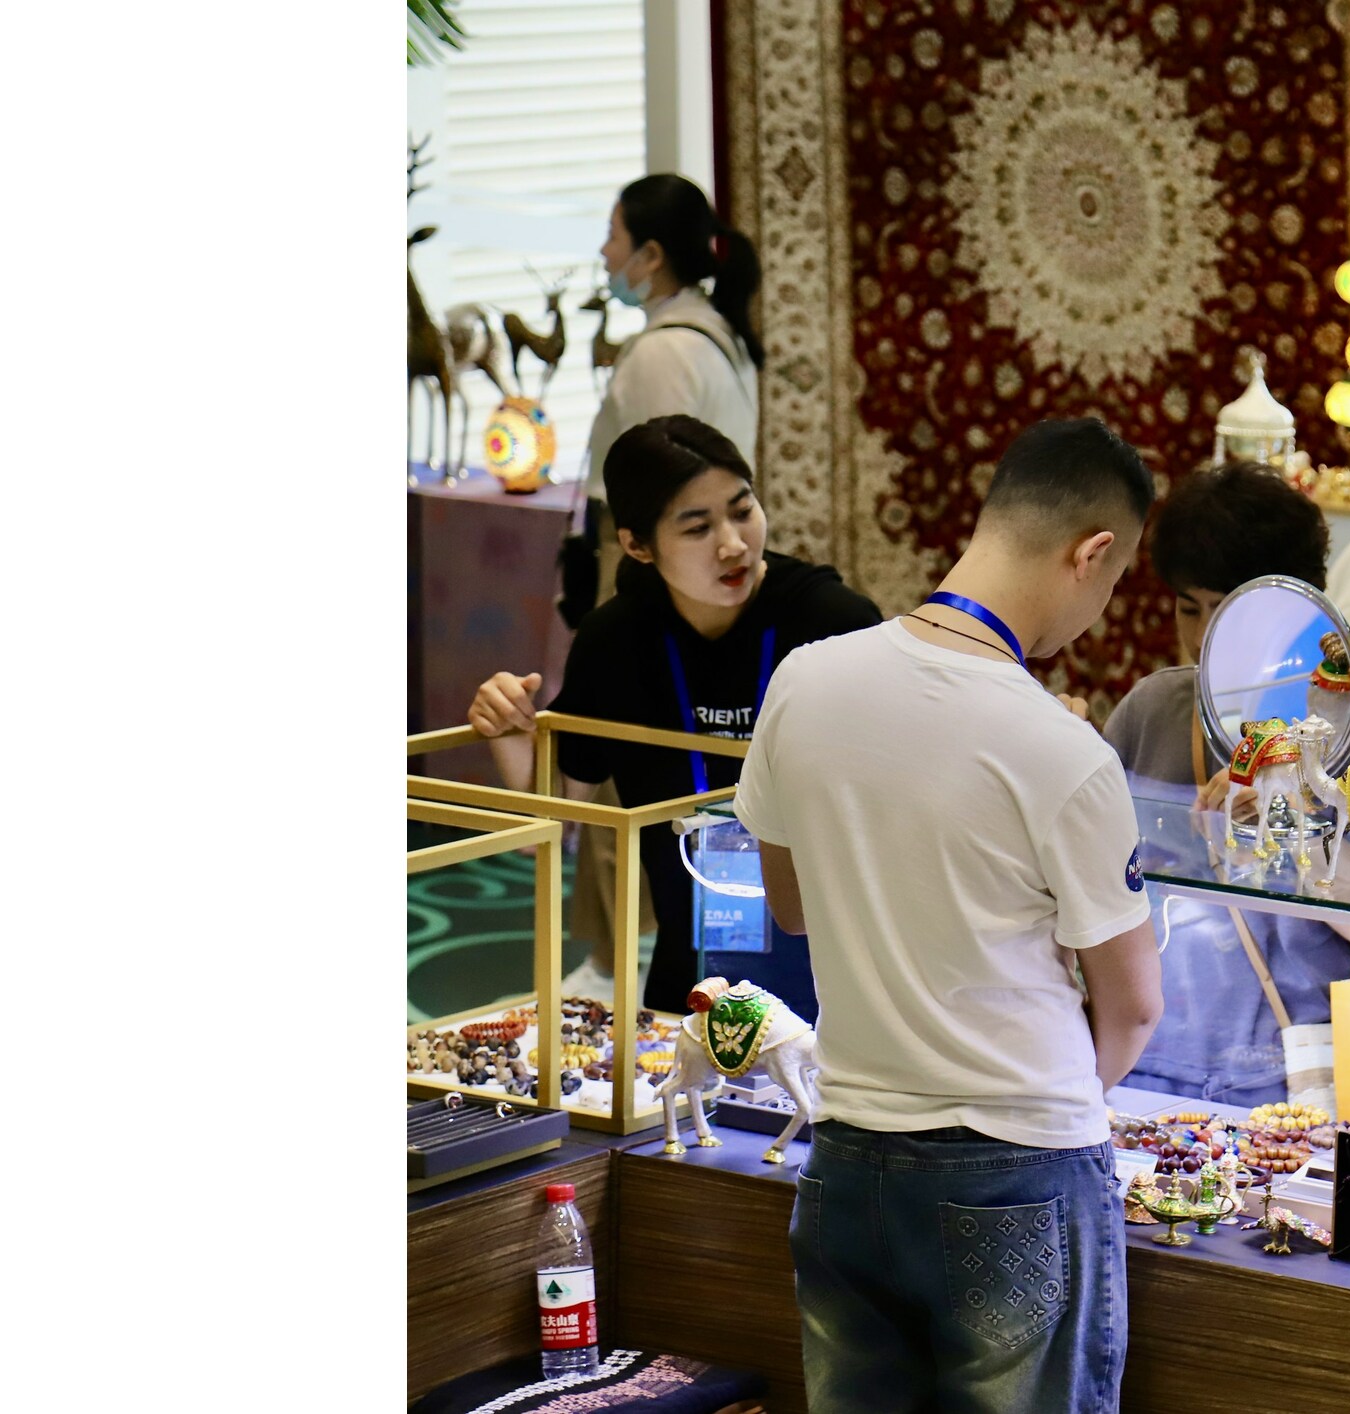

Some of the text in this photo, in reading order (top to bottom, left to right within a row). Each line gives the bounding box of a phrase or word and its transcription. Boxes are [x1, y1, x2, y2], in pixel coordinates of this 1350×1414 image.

[692, 706, 752, 726] RIENT
[704, 909, 744, 921] 工作人员
